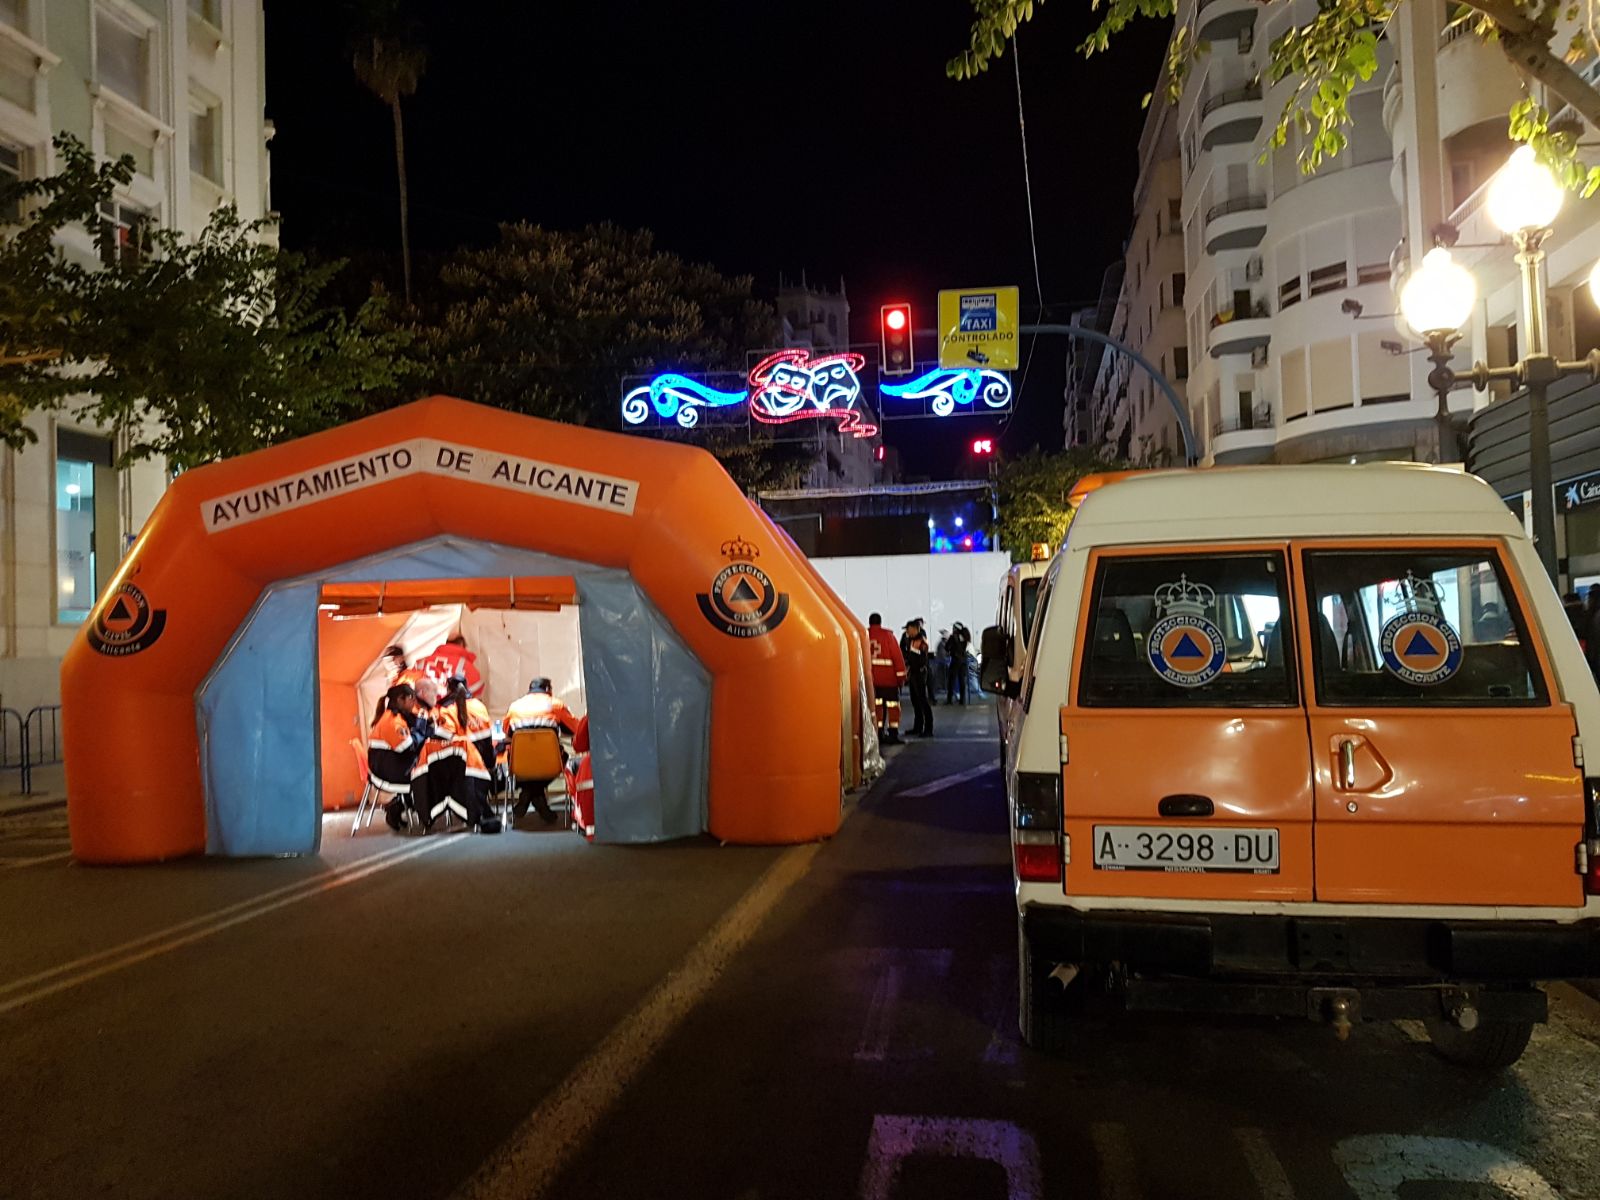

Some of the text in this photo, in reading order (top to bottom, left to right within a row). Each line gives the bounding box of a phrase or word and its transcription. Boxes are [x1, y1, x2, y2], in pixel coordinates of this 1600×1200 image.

[966, 318, 992, 331] TAXI
[943, 331, 1014, 344] CONTROLADO
[212, 447, 629, 525] AYUNTAMIENTO DE ALICANTE
[714, 565, 769, 594] PROTECCION
[727, 624, 767, 637] Alicante
[1151, 616, 1224, 655] PROTECCION CIVIL
[1383, 614, 1459, 653] PROTECCION CIVIL
[1163, 667, 1215, 683] ALICANTE
[1396, 665, 1452, 683] ALICANTE
